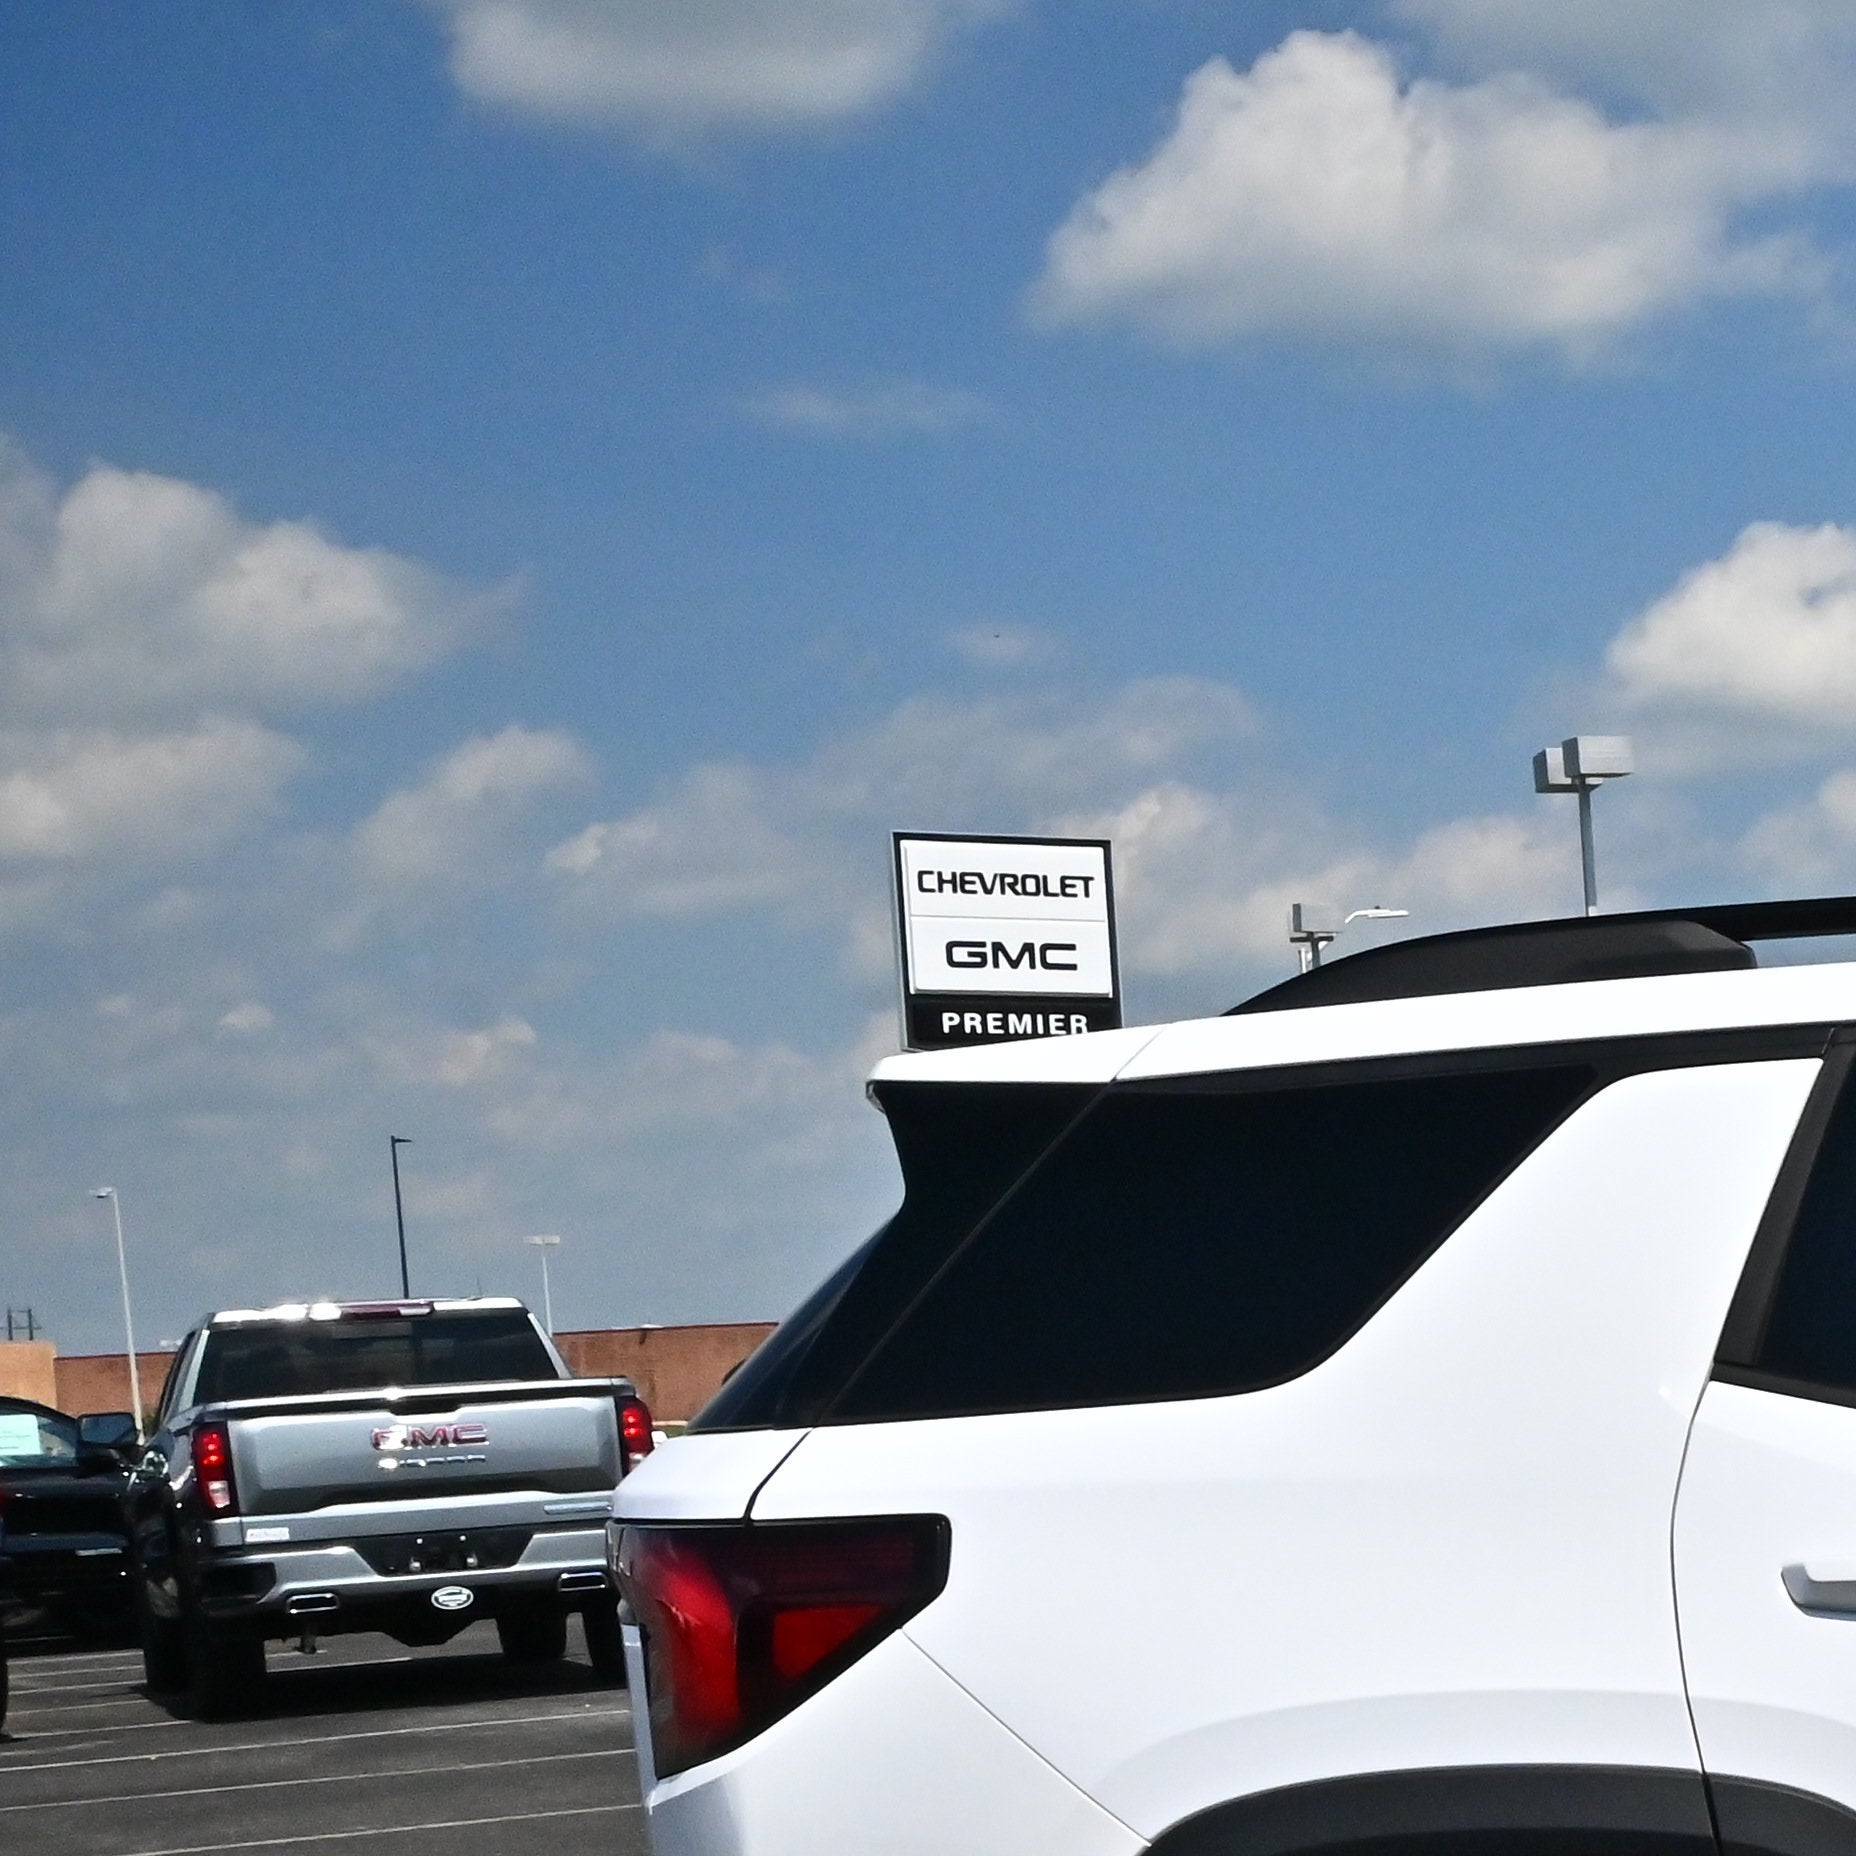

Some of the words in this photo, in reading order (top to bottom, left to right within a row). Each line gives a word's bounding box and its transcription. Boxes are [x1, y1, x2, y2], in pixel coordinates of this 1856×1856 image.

[917, 870, 1094, 898] CHEVROLET
[945, 940, 1078, 971] GMC
[941, 1011, 1088, 1035] PREMIER
